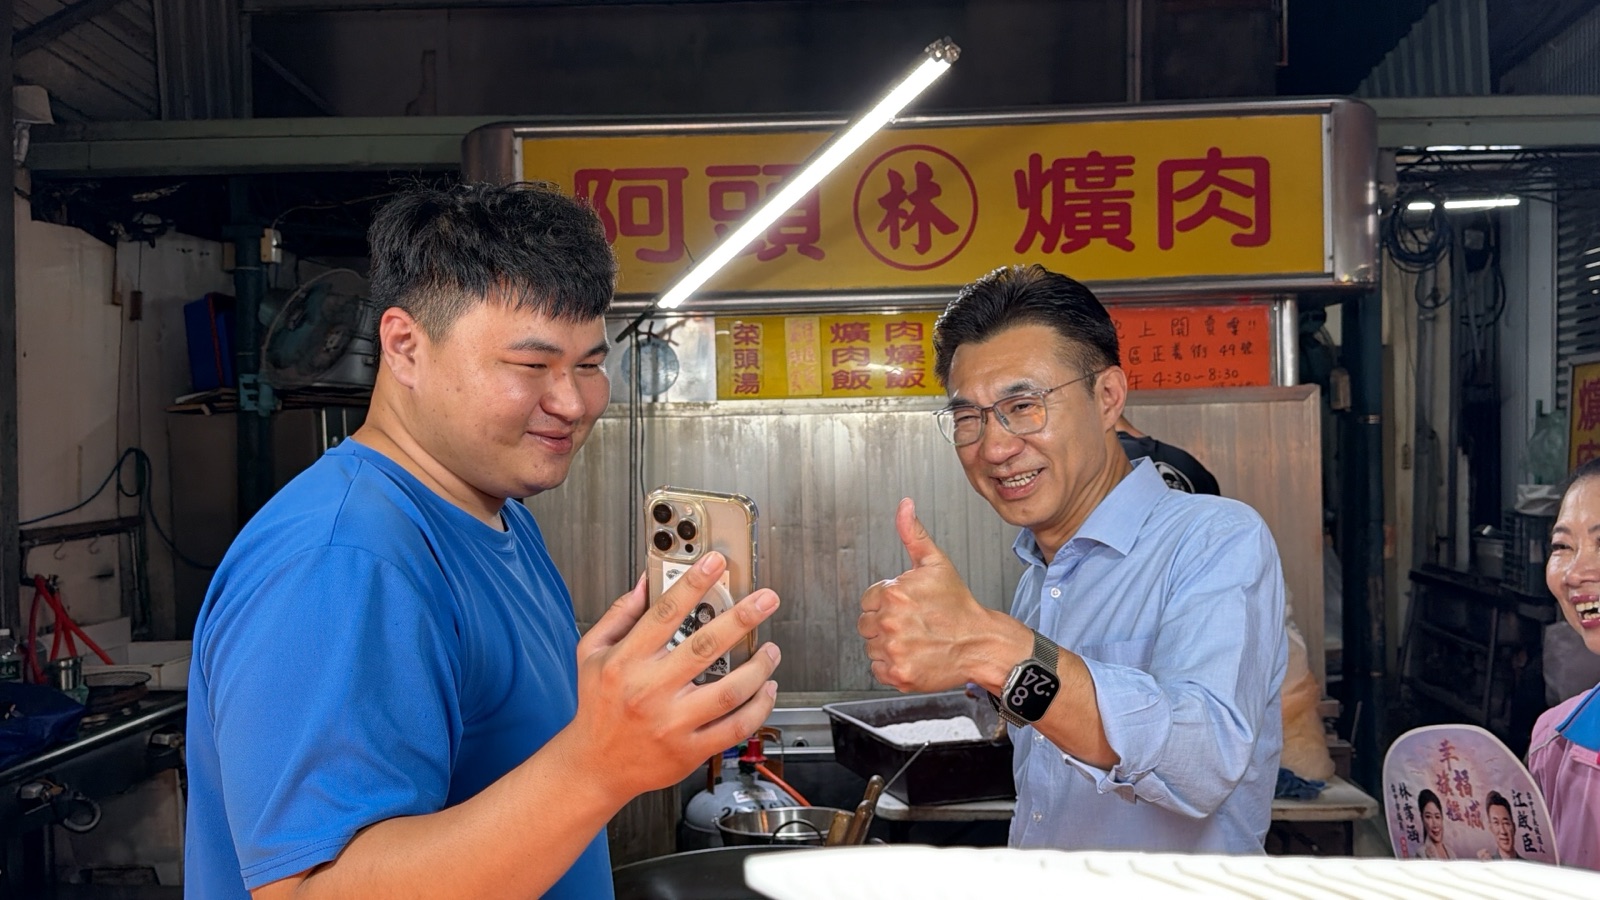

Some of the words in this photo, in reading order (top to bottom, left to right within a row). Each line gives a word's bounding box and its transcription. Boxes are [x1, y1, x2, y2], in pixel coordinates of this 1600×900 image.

[574, 164, 825, 263] 阿頭
[876, 160, 960, 256] 林
[1014, 146, 1272, 254] 爌肉
[830, 321, 873, 391] 爌肉飯
[884, 320, 926, 389] 肉燥飯
